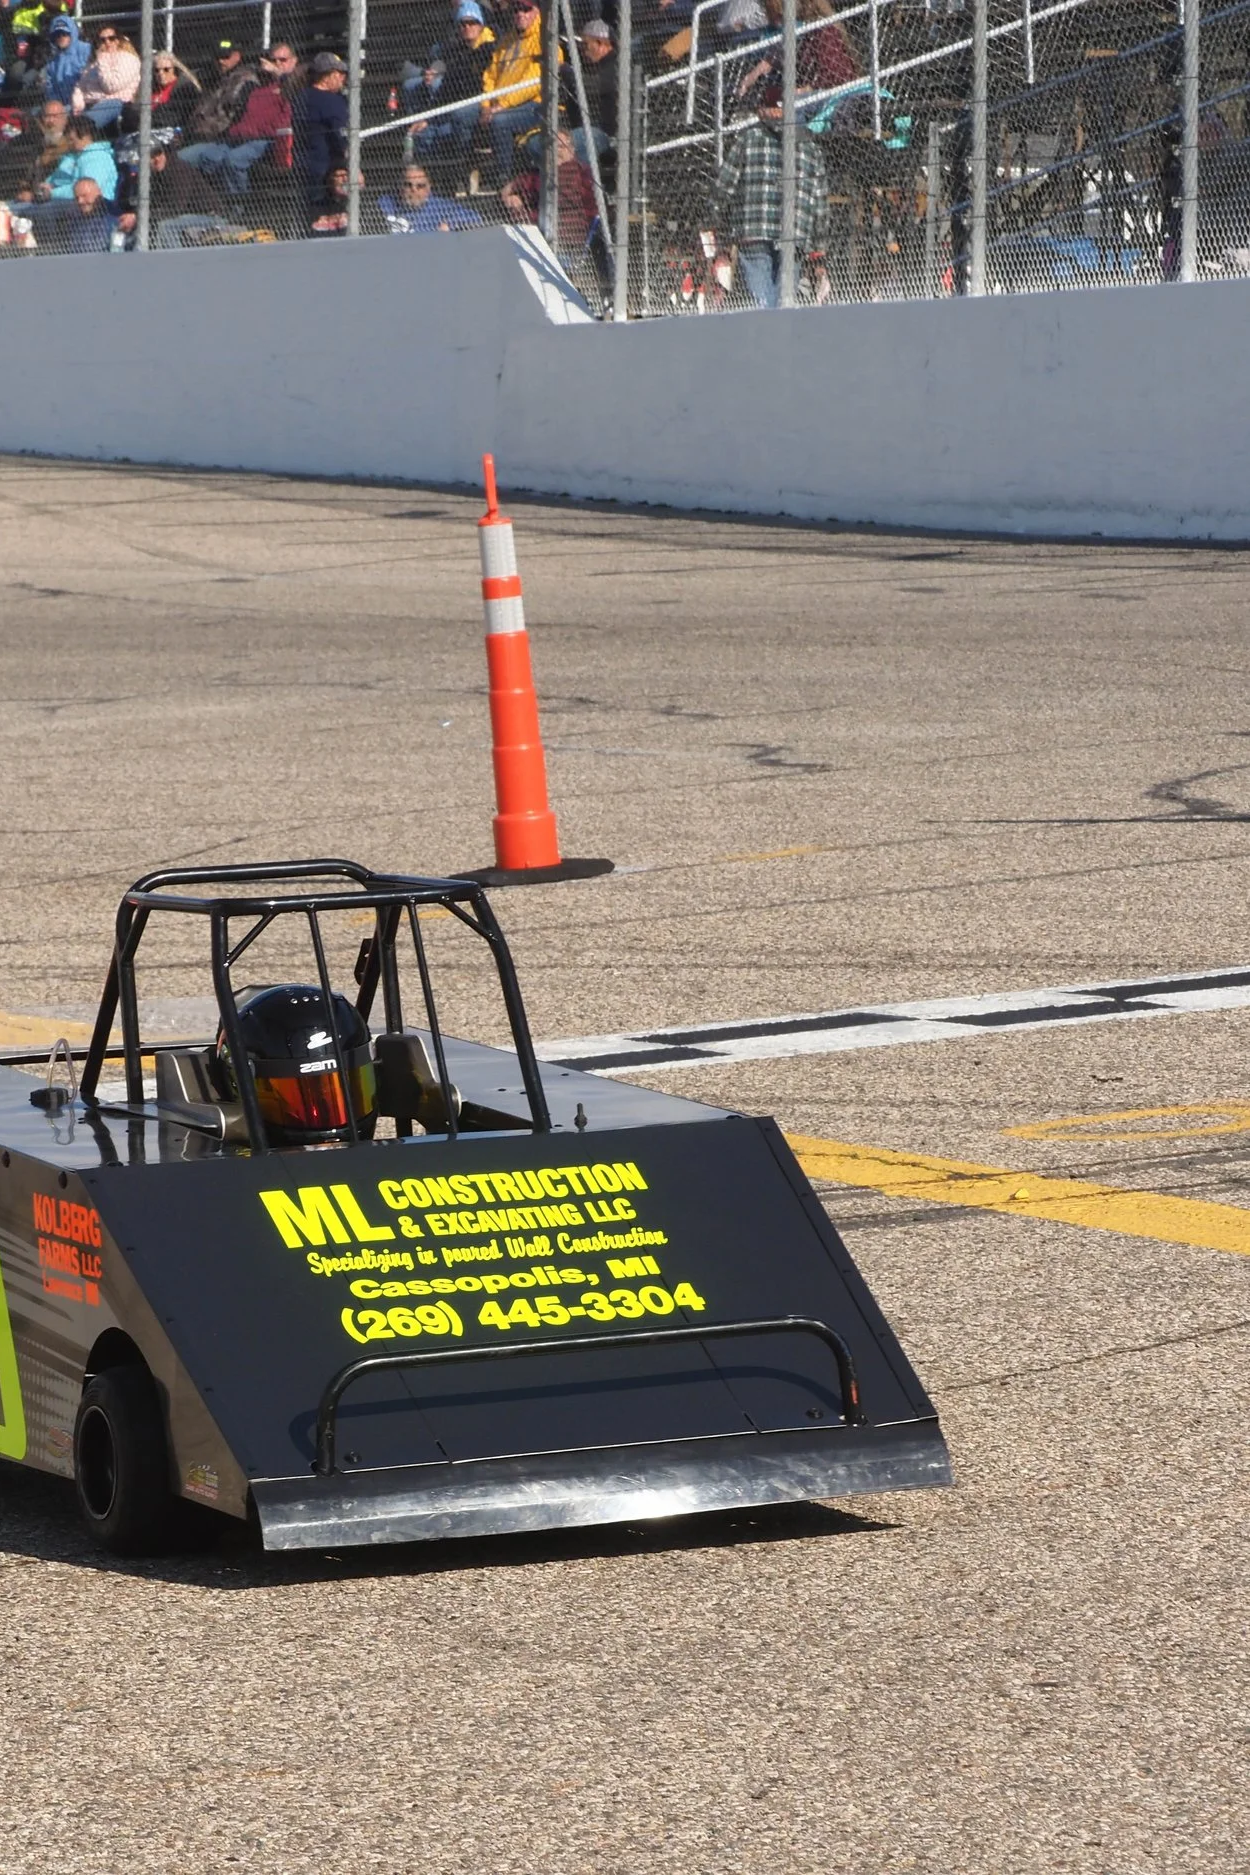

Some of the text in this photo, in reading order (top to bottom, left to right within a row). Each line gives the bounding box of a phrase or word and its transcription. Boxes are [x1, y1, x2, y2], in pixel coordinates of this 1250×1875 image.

[33, 1192, 102, 1248] KOLBERG
[258, 1161, 649, 1249] ML CONSTRUCTION
[397, 1197, 637, 1239] & EXCAVATING LLC
[38, 1237, 102, 1278] FARMS LLC
[306, 1225, 669, 1276] Specializing in poured Wall Construction
[349, 1256, 662, 1300] Cassopolis, MI
[341, 1283, 706, 1344] (269) 445-3304
